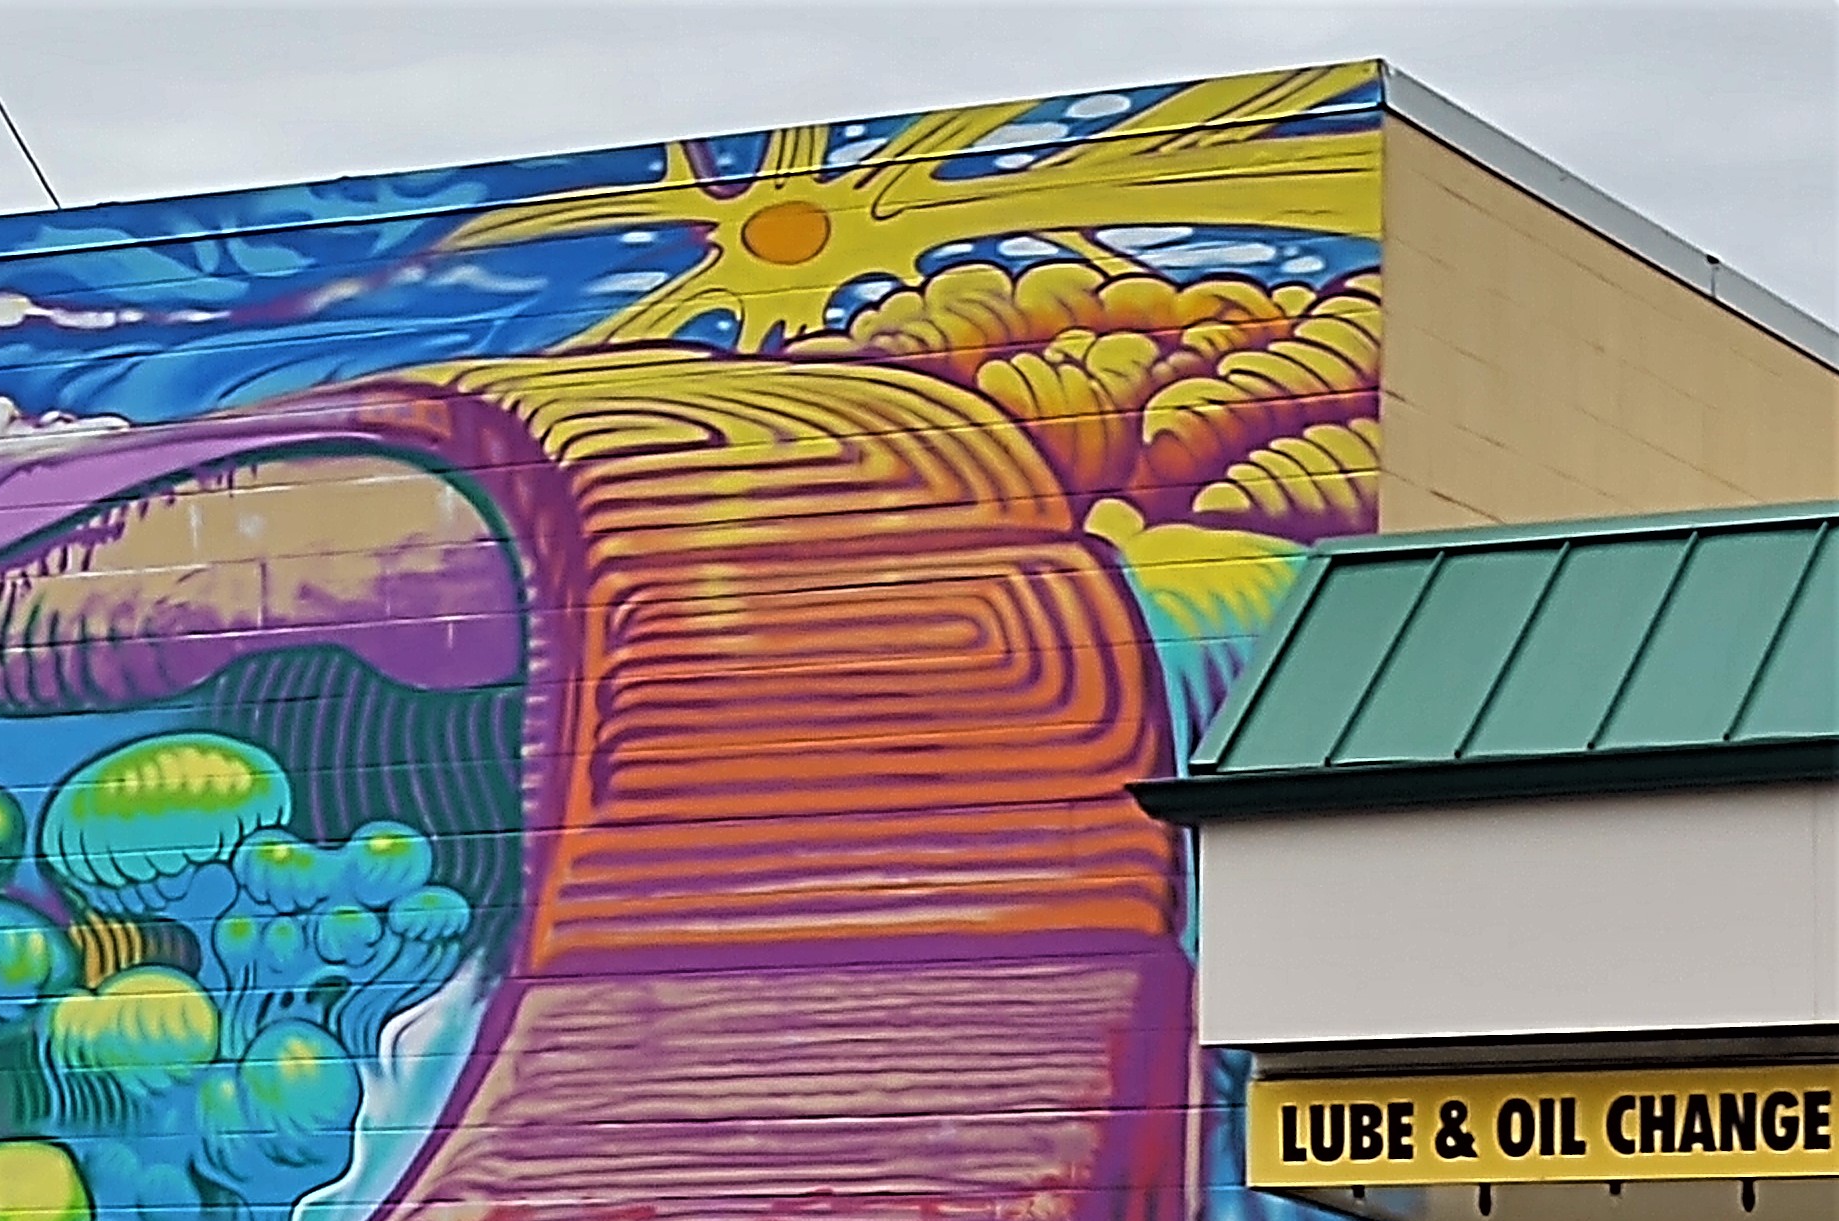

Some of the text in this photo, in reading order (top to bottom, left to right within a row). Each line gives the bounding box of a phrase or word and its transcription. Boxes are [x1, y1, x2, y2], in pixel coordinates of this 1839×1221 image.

[1281, 1090, 1832, 1162] LUBE & OIL CHANGE
